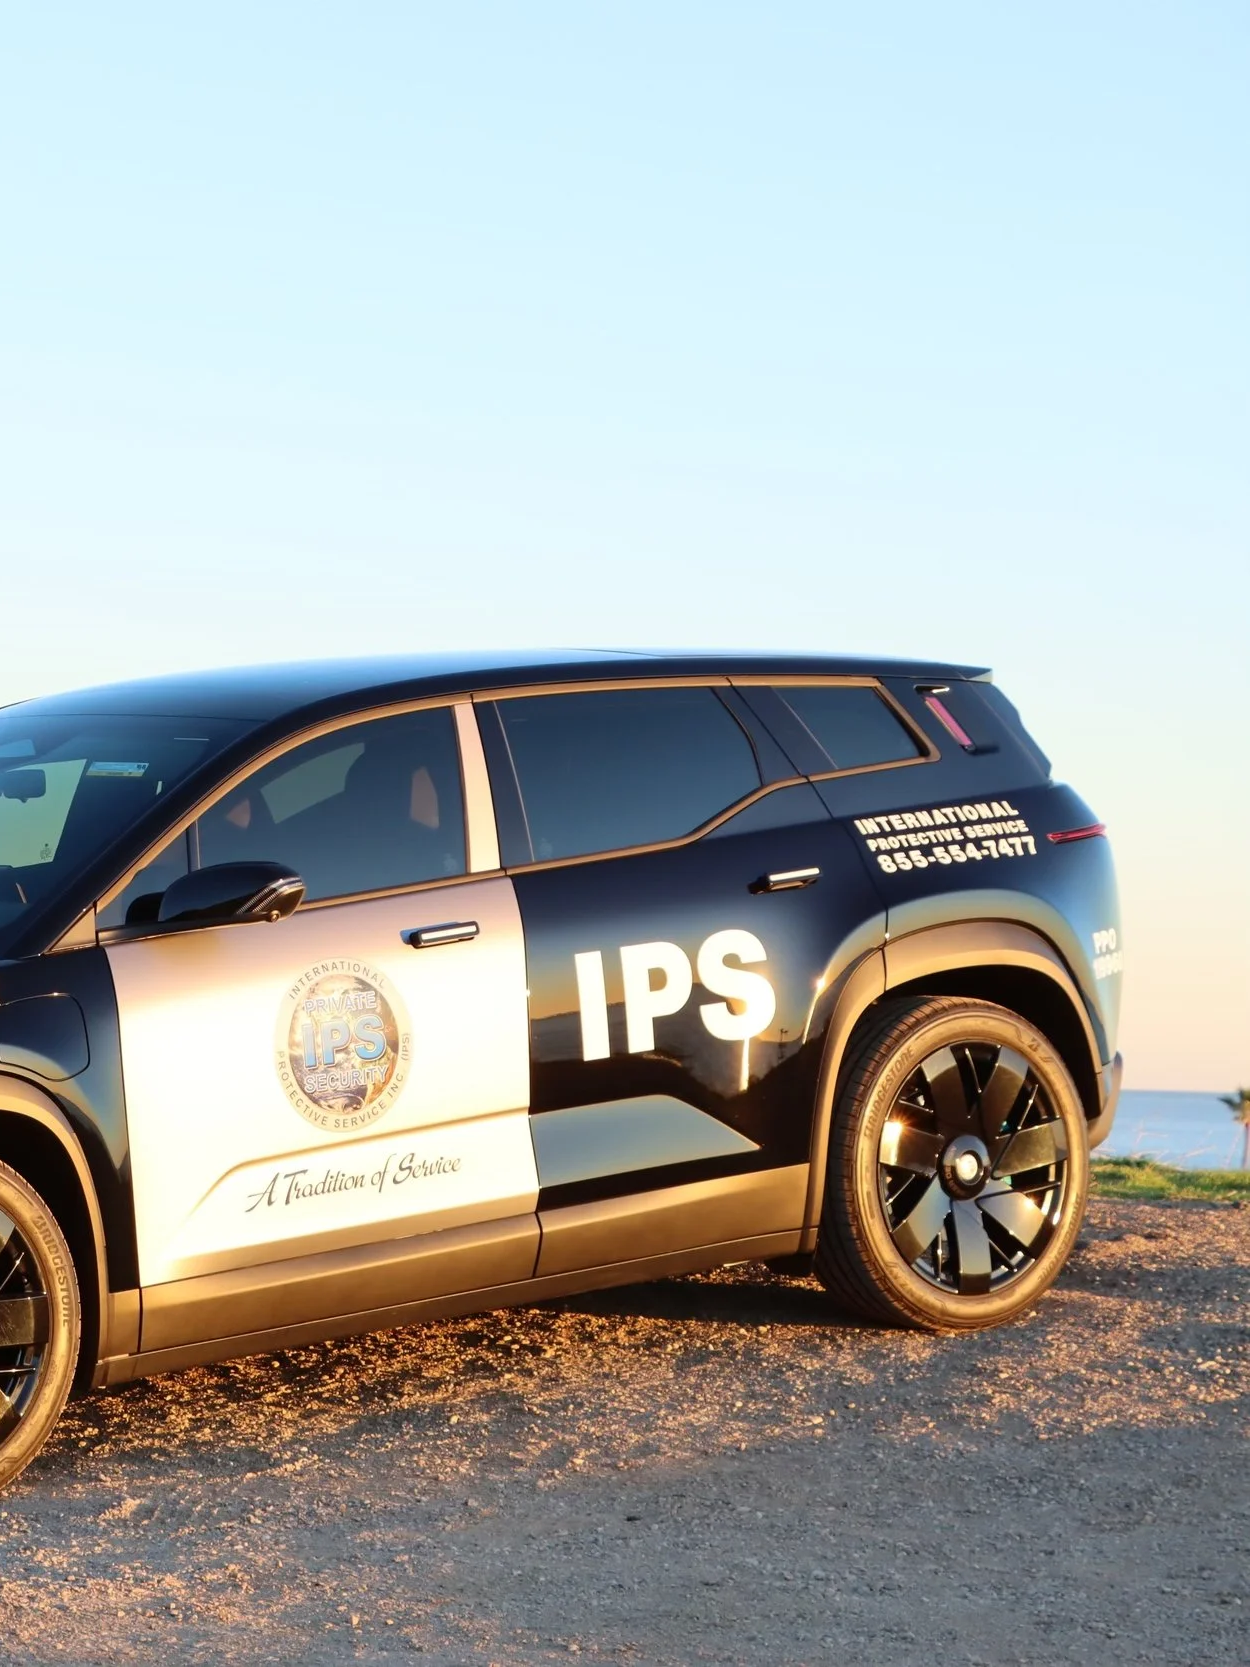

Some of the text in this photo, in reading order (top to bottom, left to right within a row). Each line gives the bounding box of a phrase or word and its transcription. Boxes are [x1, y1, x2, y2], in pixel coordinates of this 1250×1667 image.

[854, 800, 1019, 835] INTERNATIONAL
[866, 819, 1029, 852] PROTECTIVE SERVICE
[877, 835, 1037, 873] 855-554-7477
[289, 961, 385, 1000] INTERNATIONAL
[574, 929, 776, 1062] IPS
[304, 990, 377, 1015] PRIVATE
[301, 1014, 388, 1069] IPS
[277, 1050, 329, 1127] PROTECTIVE
[334, 1101, 387, 1129] SERVICE
[304, 1065, 389, 1094] SECURITY
[245, 1153, 462, 1213] A Tradition of Service
[33, 1216, 70, 1327] BRIDGESTONE
